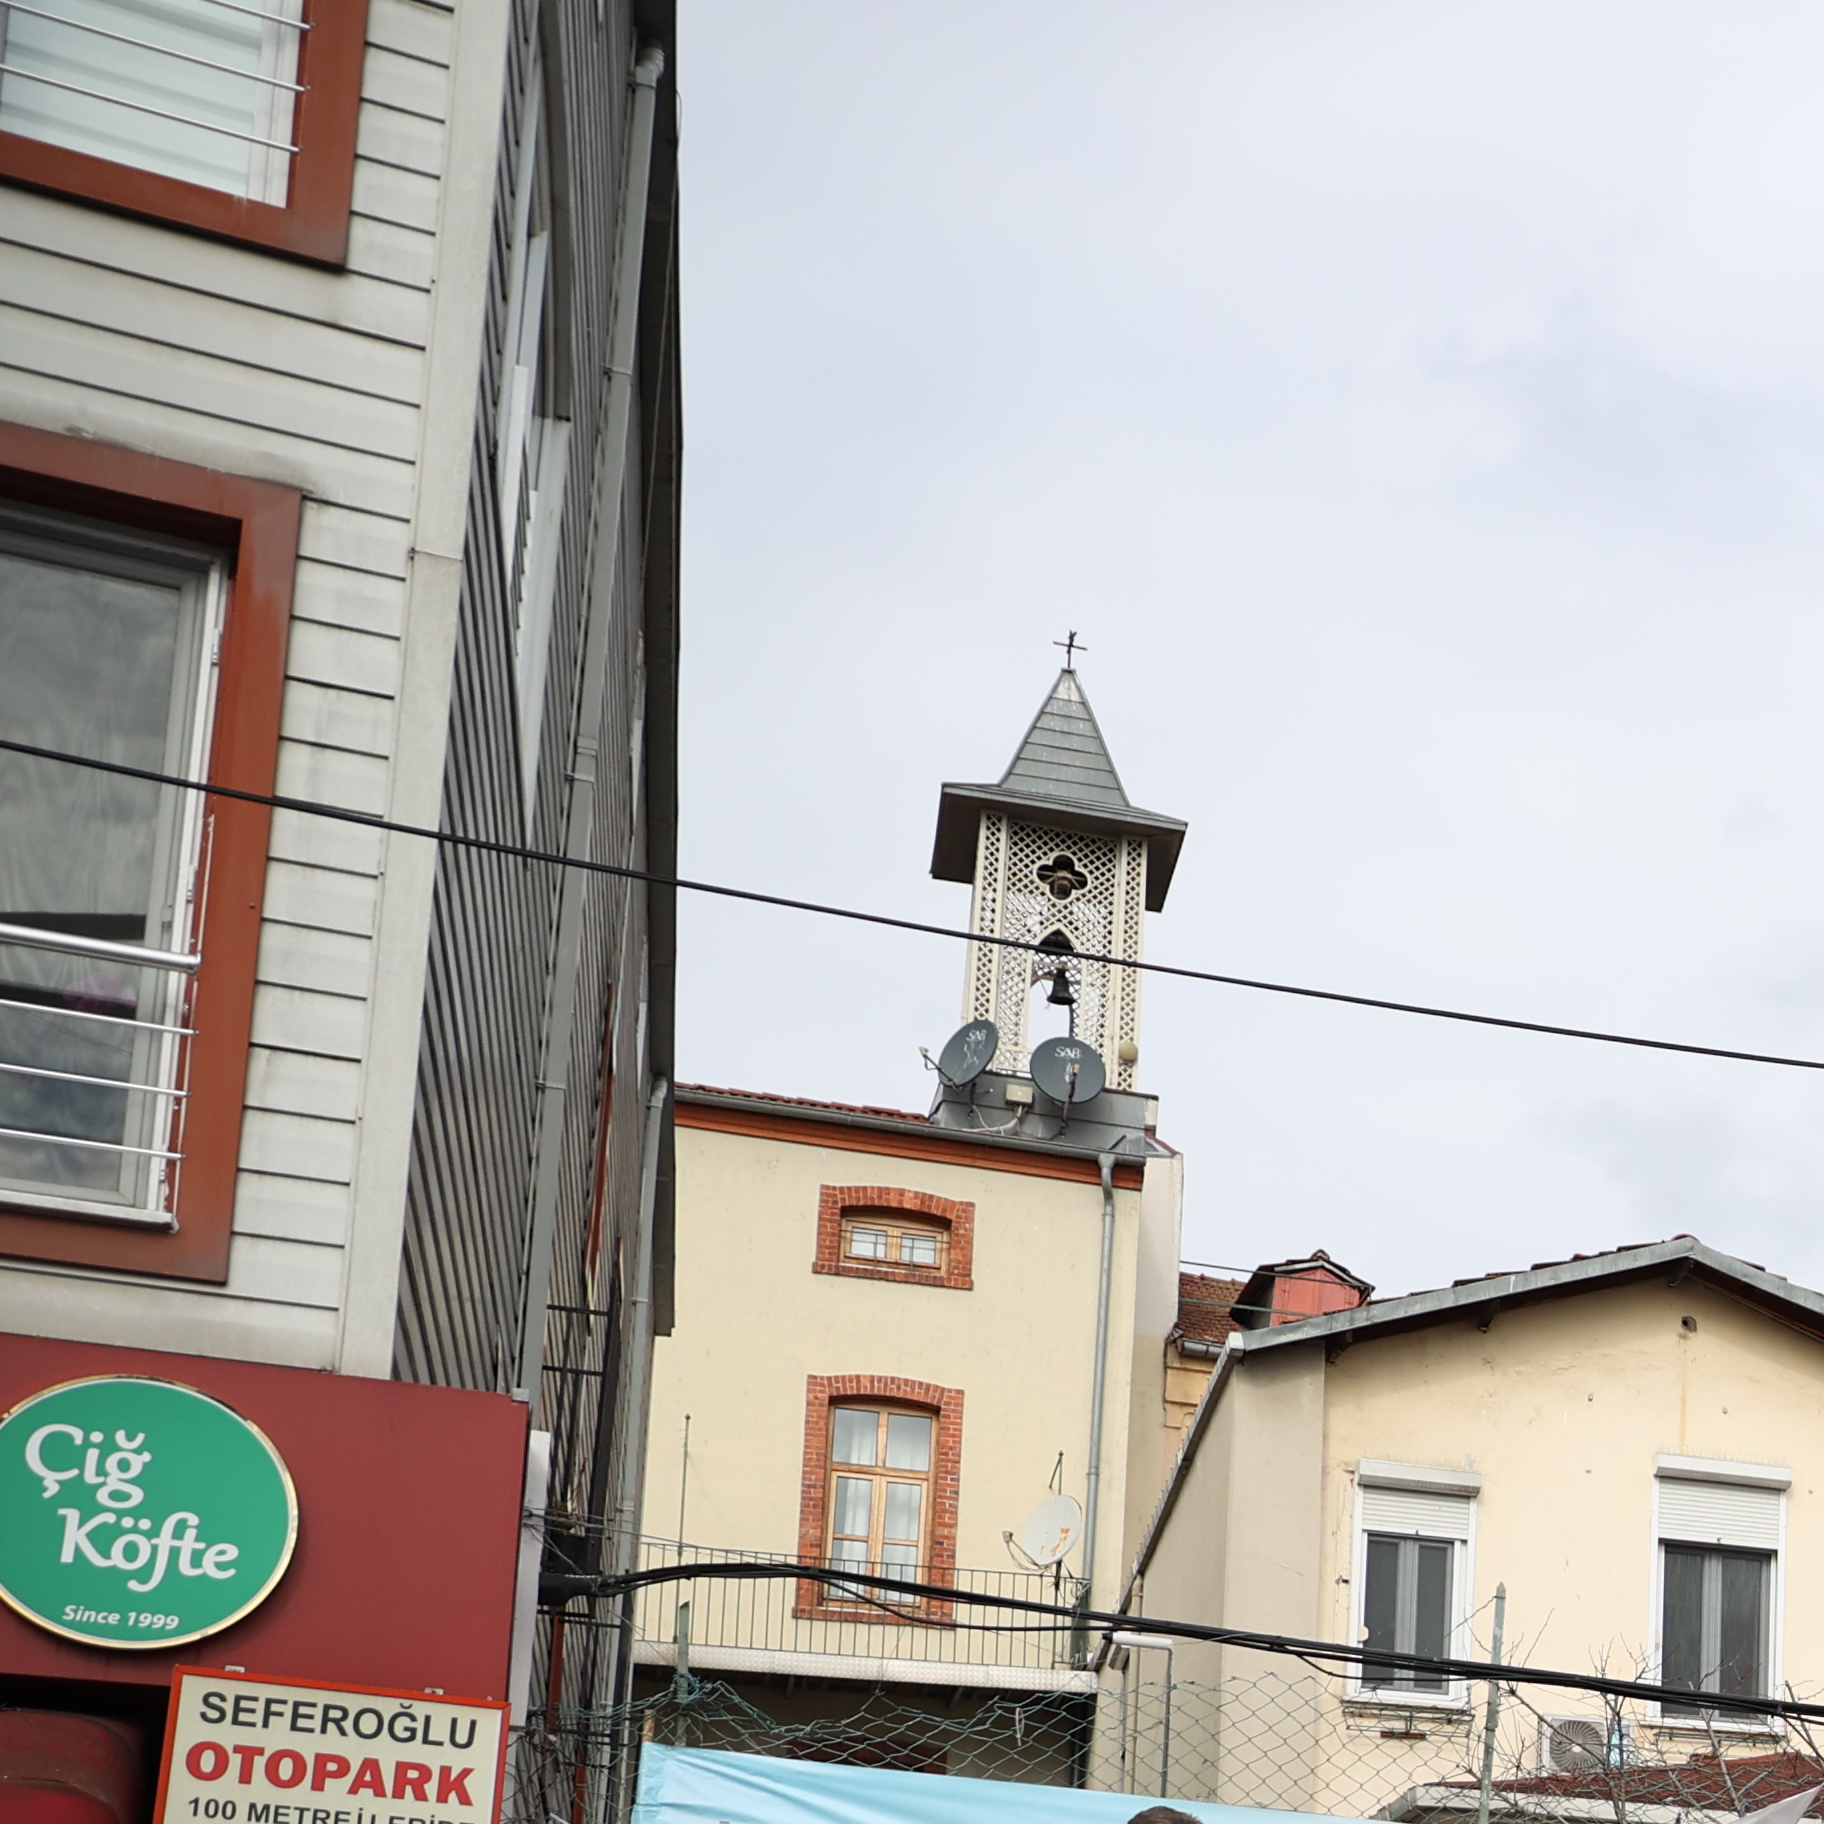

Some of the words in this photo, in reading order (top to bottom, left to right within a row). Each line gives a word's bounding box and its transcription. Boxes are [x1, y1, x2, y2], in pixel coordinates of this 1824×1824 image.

[25, 1423, 152, 1509] Çiğ
[57, 1507, 239, 1592] Köfte
[62, 1605, 121, 1625] Since
[127, 1611, 180, 1630] 1999
[199, 1691, 477, 1749] SEFEROĞLU
[185, 1741, 475, 1806] OTOPARK
[188, 1797, 237, 1820] 100
